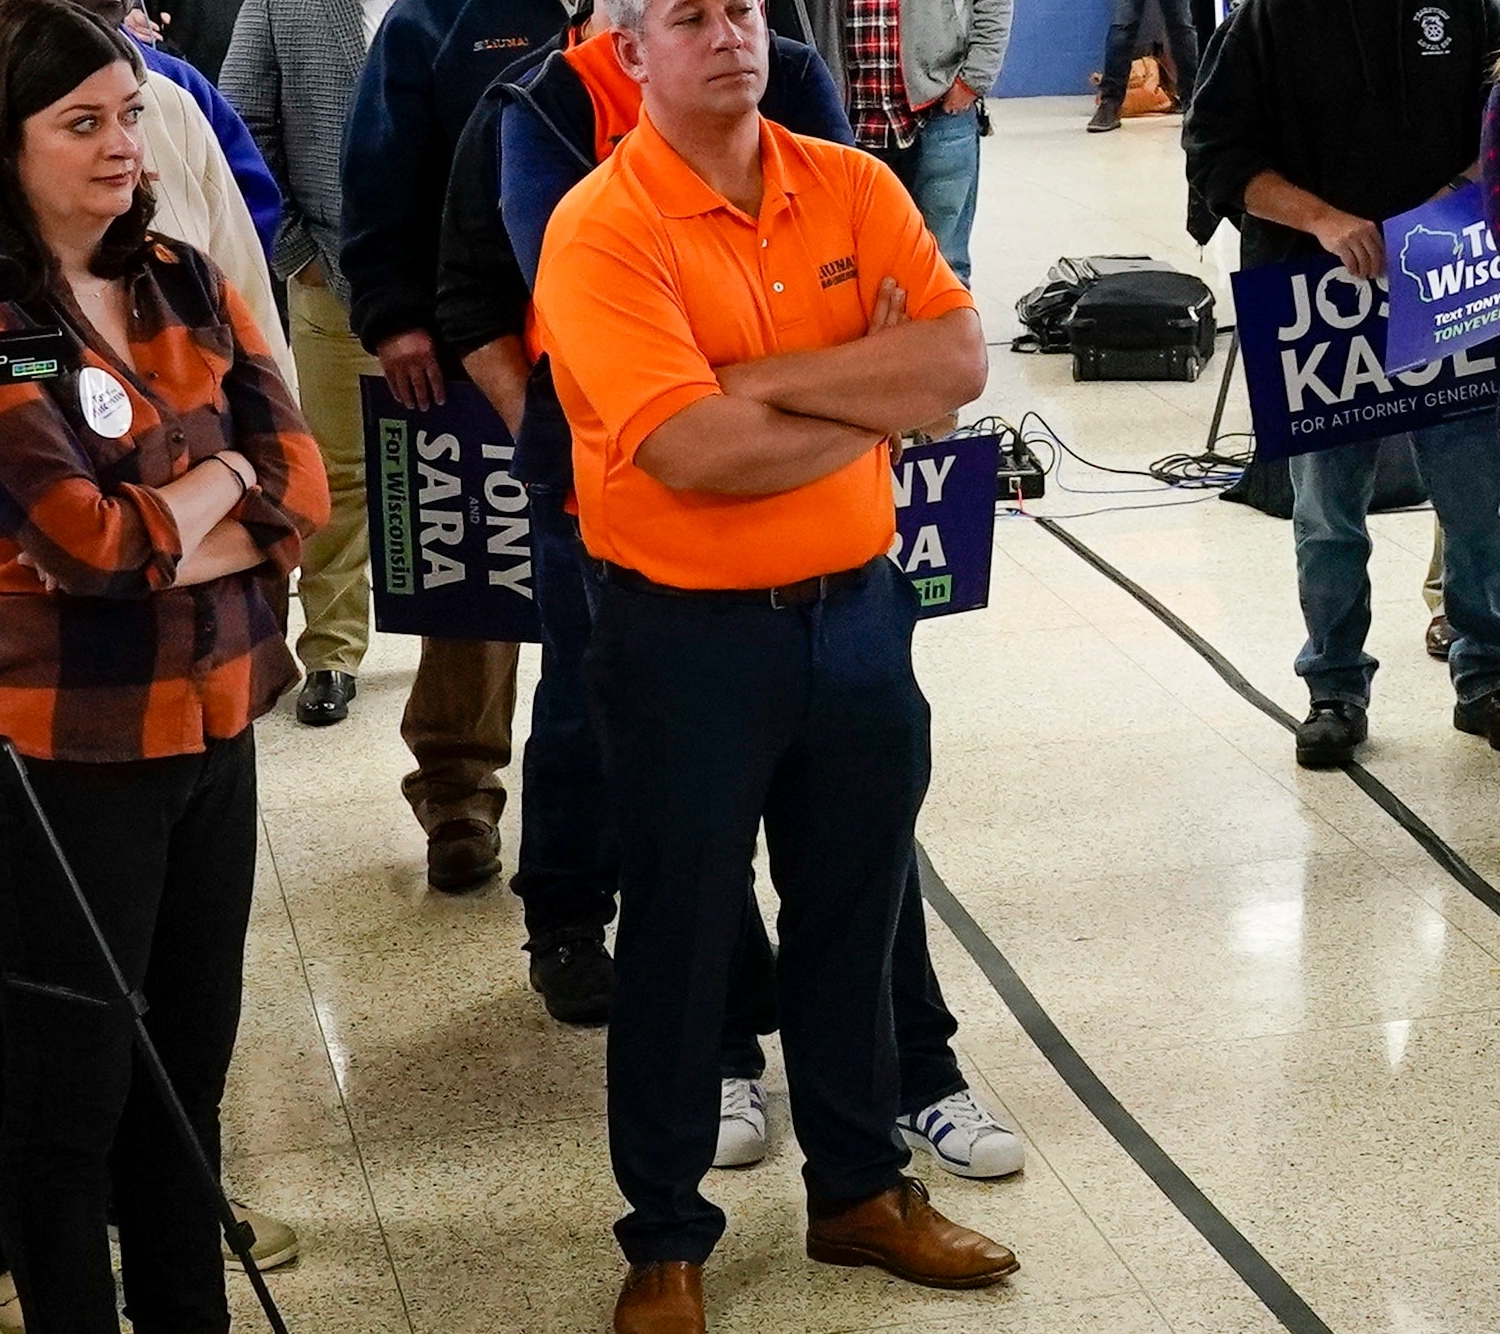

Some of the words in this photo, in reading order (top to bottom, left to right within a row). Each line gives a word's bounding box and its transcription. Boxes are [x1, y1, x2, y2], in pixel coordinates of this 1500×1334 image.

[1435, 307, 1463, 326] Text
[1291, 417, 1325, 436] FOR
[1332, 395, 1418, 428] ATTORNEY
[1424, 380, 1498, 408] GENERAL
[385, 426, 403, 463] For
[891, 455, 957, 509] NY
[386, 471, 407, 589] Wisconsin
[416, 430, 466, 590] SARA
[469, 496, 480, 525] AND
